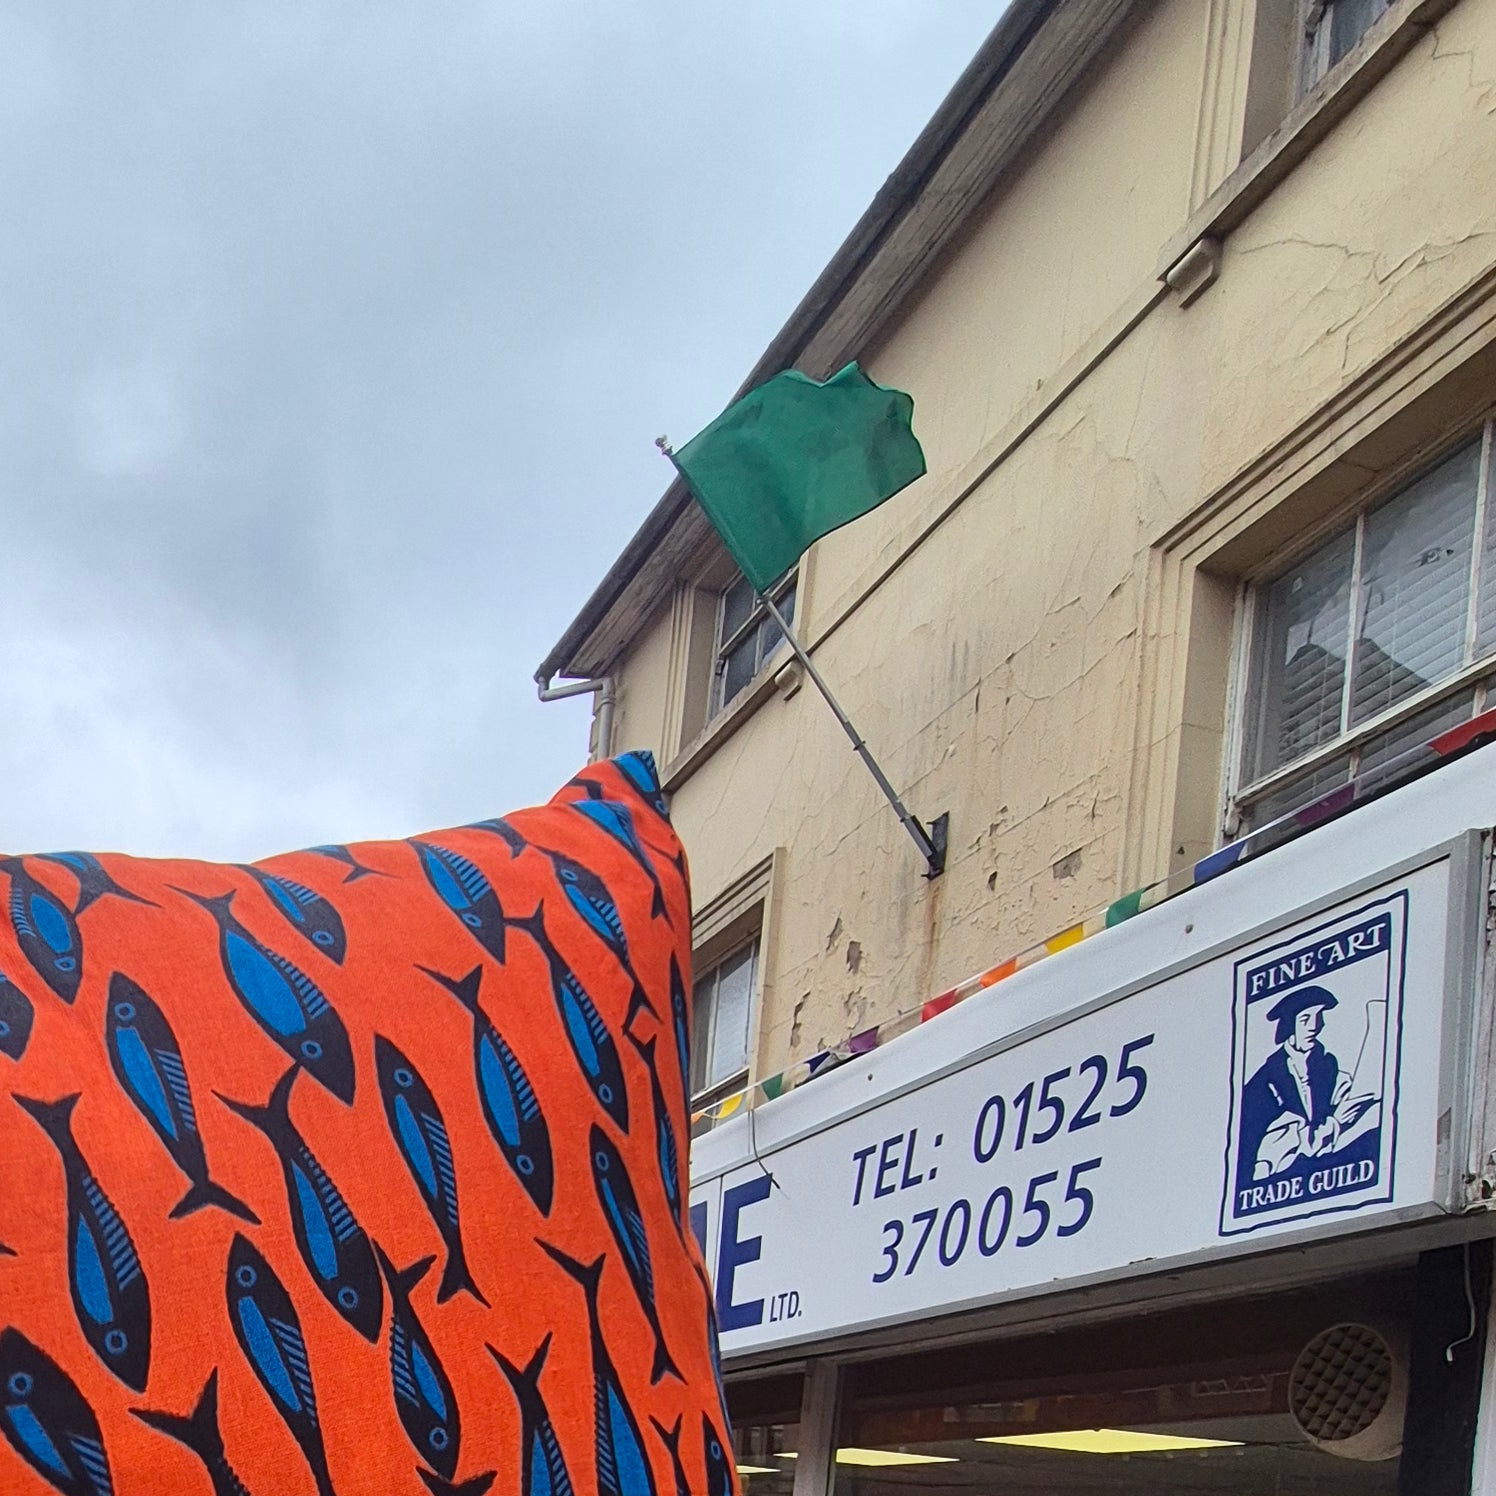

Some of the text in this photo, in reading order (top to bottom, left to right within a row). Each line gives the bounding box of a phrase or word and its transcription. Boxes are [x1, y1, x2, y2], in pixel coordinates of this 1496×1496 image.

[1249, 922, 1386, 997] FINE ART
[852, 1032, 1156, 1207] TEL: 01525
[872, 1156, 1103, 1284] 370055
[1238, 1159, 1376, 1212] TRADE GUILD
[689, 1172, 803, 1334] E LTD.
